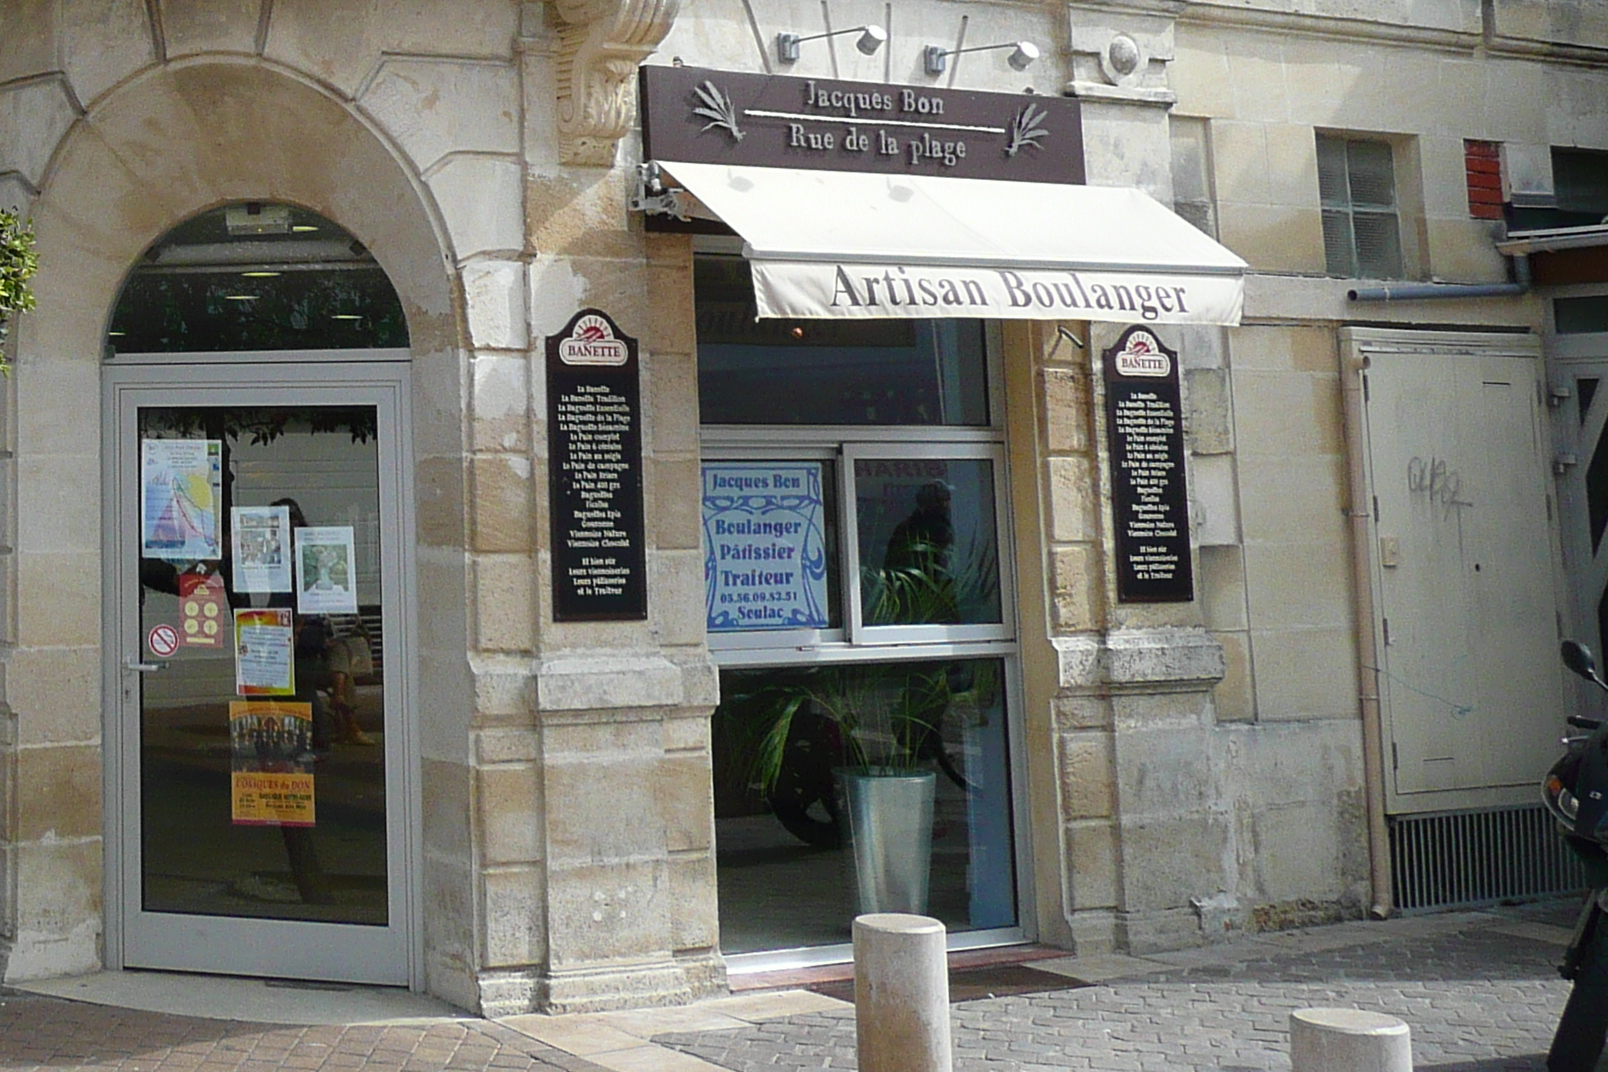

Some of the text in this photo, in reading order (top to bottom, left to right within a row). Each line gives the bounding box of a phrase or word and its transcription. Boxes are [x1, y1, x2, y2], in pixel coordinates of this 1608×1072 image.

[807, 81, 944, 116] Jacques Bon
[790, 123, 966, 166] Rue de la plage
[830, 264, 1190, 320] Artisan Boulanger
[568, 346, 620, 357] BANETTE
[1122, 359, 1164, 368] BANETTE
[713, 474, 800, 491] Jacques Bon
[715, 519, 801, 538] Boulanger
[720, 543, 795, 560] Pâtissier
[721, 569, 794, 586] Traiteur
[737, 605, 784, 620] Soulac
